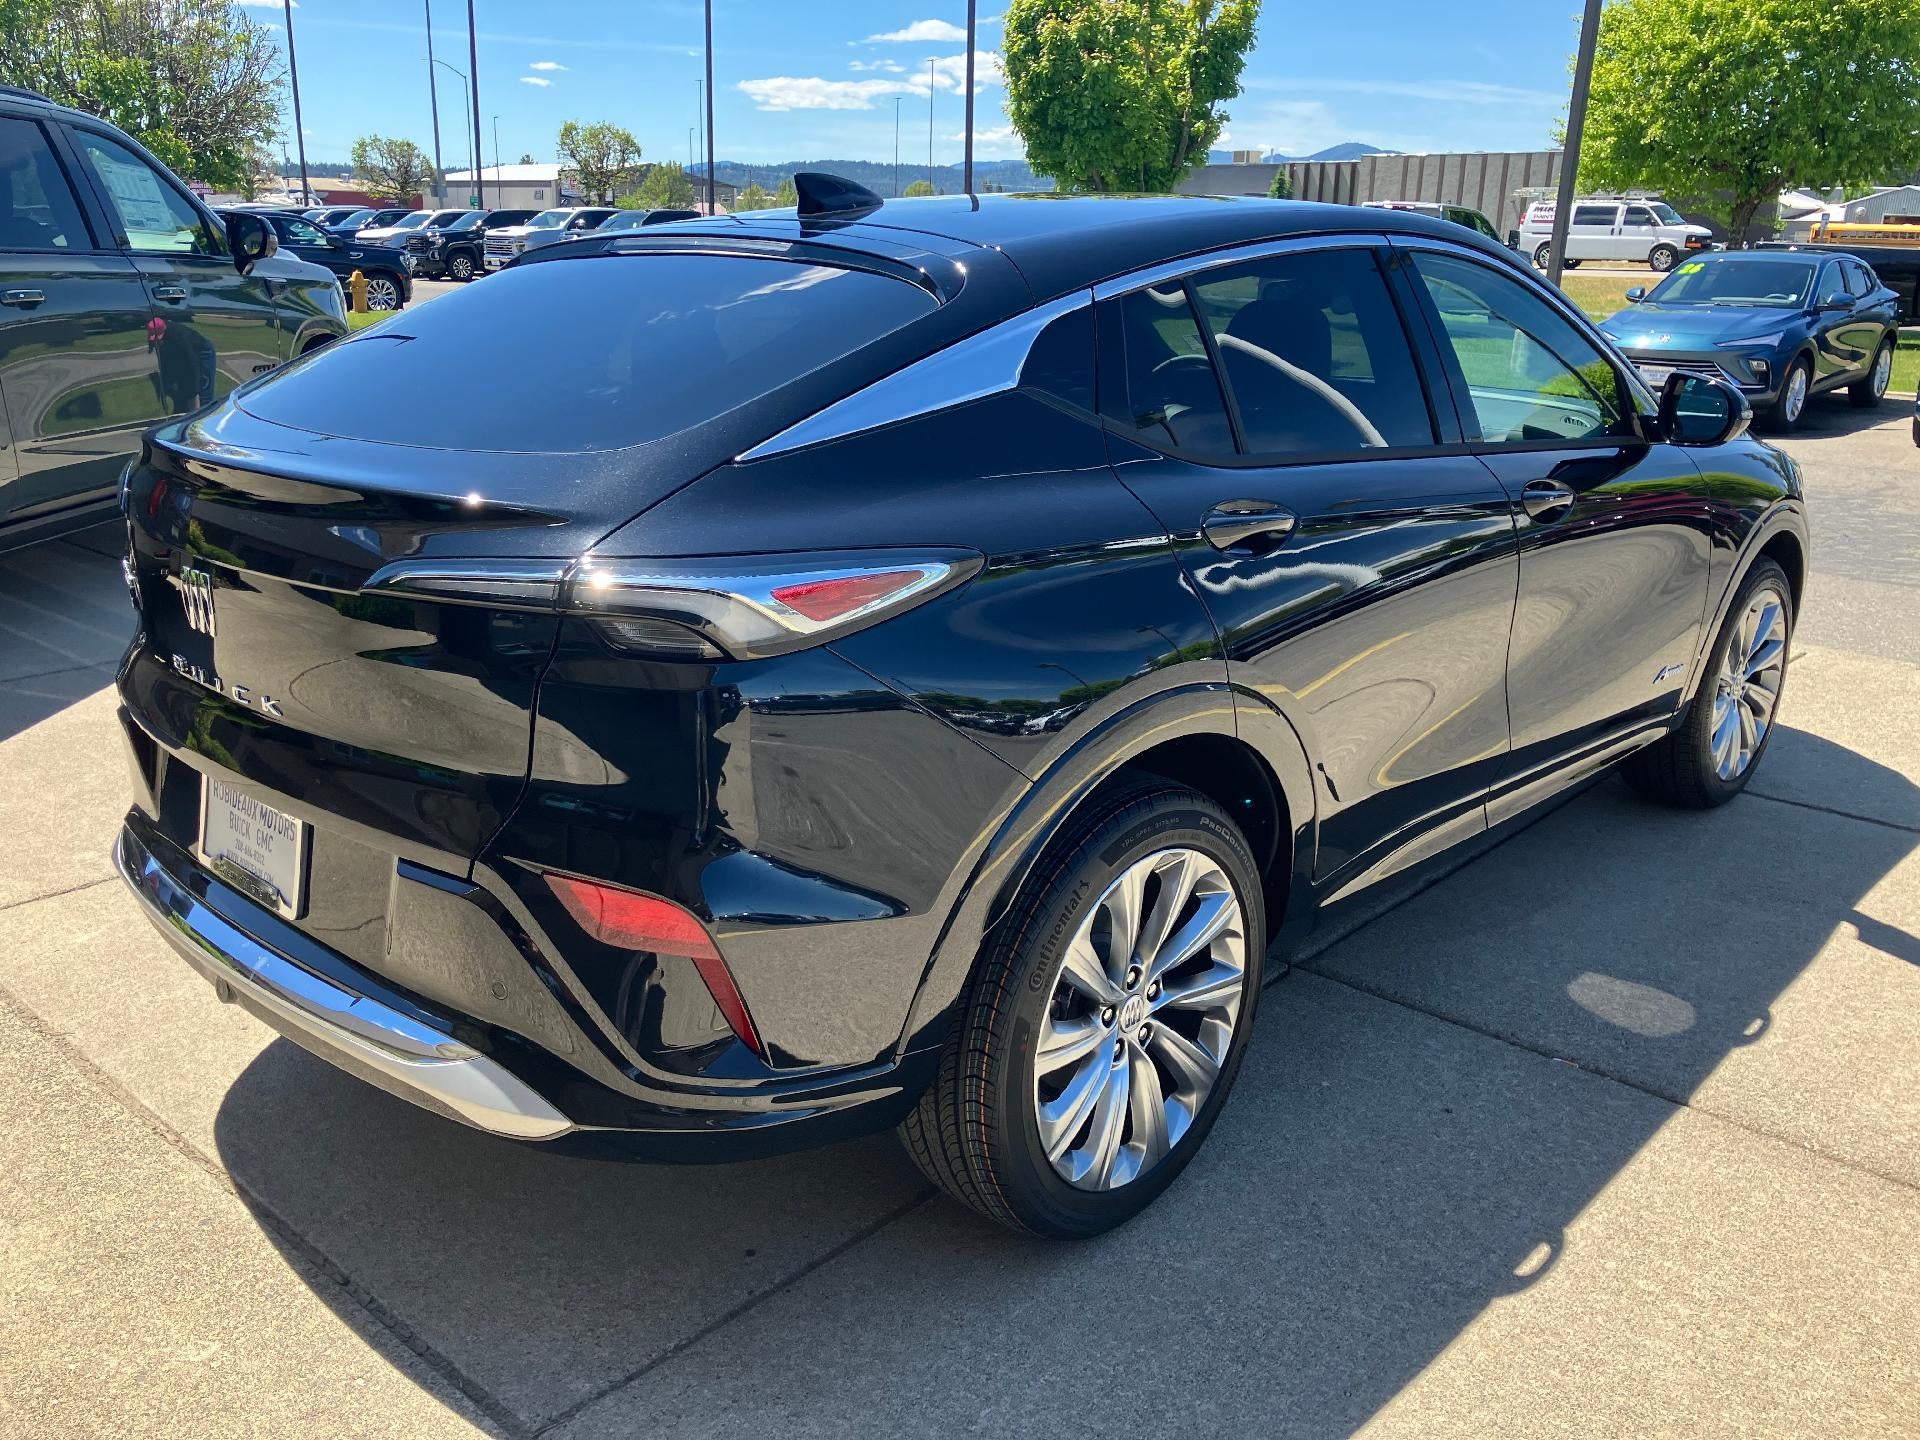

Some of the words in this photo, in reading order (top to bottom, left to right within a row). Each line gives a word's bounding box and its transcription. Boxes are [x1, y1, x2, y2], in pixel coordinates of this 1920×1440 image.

[213, 780, 259, 820] ROBIDEAUX
[259, 805, 296, 841] MOTORS
[229, 811, 251, 841] BUICK
[256, 828, 274, 853] GMC
